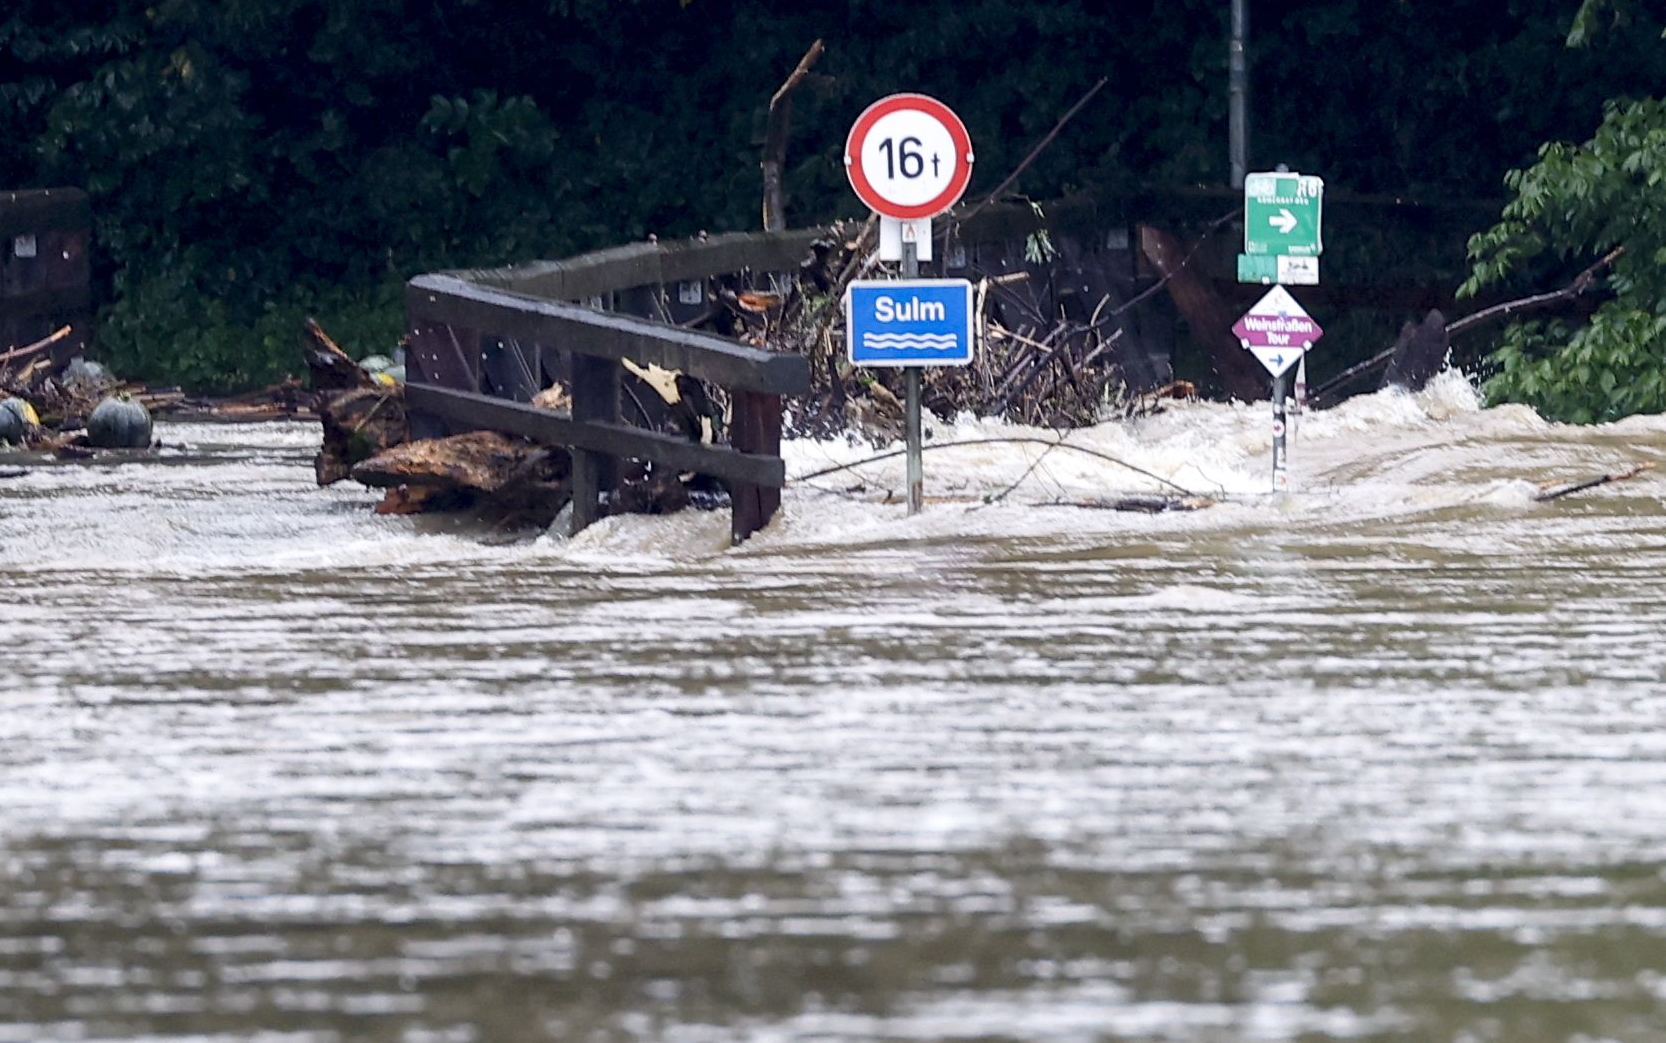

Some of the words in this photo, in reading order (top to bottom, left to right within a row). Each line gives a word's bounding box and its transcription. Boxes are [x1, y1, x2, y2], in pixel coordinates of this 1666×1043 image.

[875, 296, 945, 322] Sulm
[1244, 316, 1313, 333] Weinstraßen
[1266, 331, 1291, 345] Tour
